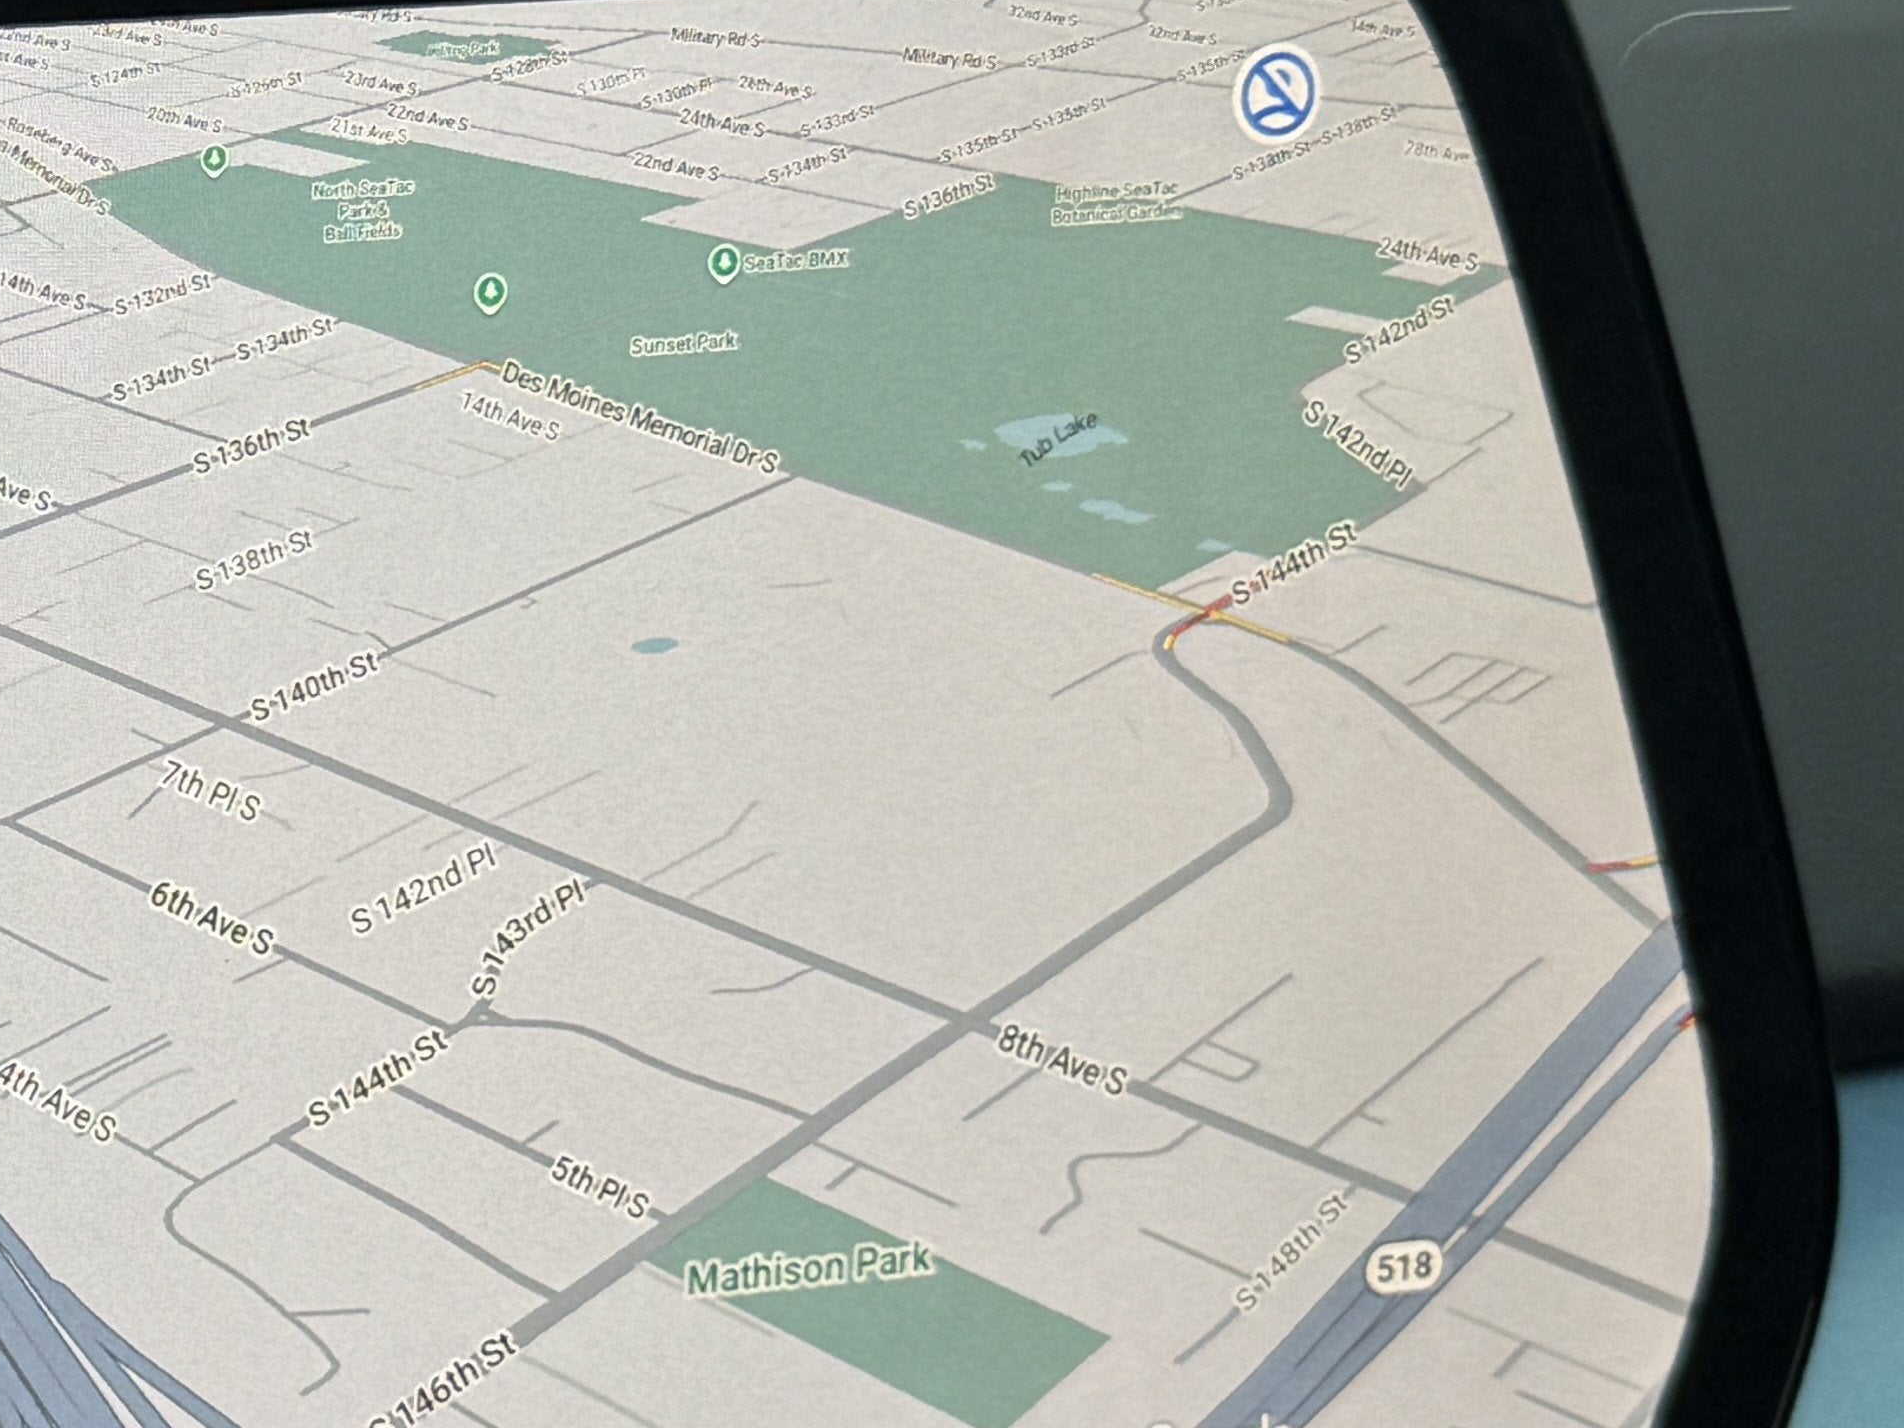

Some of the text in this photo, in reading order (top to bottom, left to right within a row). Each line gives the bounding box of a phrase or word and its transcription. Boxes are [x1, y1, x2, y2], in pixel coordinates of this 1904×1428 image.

[904, 174, 994, 220] S 136th St
[1379, 239, 1478, 271] 24th Ave S
[632, 332, 737, 356] Sunset Park
[1345, 298, 1454, 364] S 142nd St
[502, 361, 778, 473] Des Moines Memorial Dr S
[1020, 413, 1098, 468] Tub Lake
[1232, 523, 1357, 605] S 144th St
[151, 882, 274, 955] 6th Ave S
[351, 843, 495, 934] S 142nd Pl
[304, 1031, 448, 1127] S 144th St
[995, 1024, 1127, 1095] 8th Ave S
[687, 1243, 931, 1294] Mathison Park
[1377, 1252, 1432, 1281] 518
[388, 1361, 479, 1425] 146th
[471, 1334, 516, 1375] St
